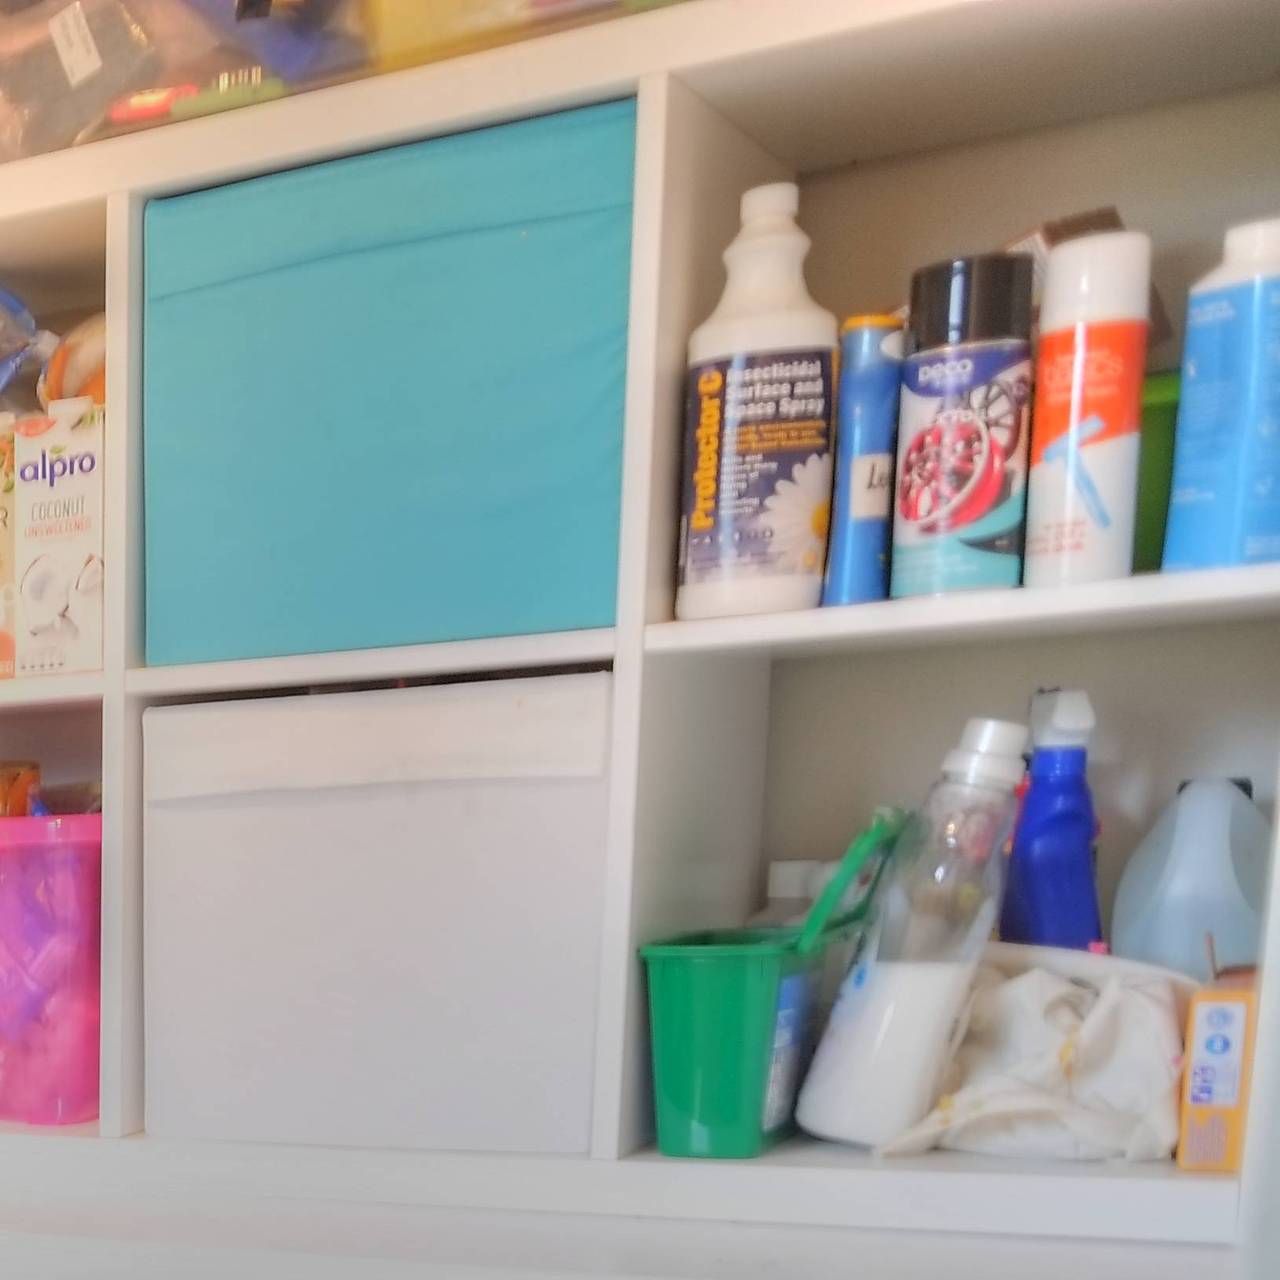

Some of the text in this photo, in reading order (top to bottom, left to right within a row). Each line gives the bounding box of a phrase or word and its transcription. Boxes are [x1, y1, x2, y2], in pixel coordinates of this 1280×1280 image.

[793, 378, 824, 396] and
[779, 397, 825, 418] Spray
[19, 447, 96, 488] alpro
[689, 395, 721, 531] Protector
[31, 495, 86, 522] COCONUT
